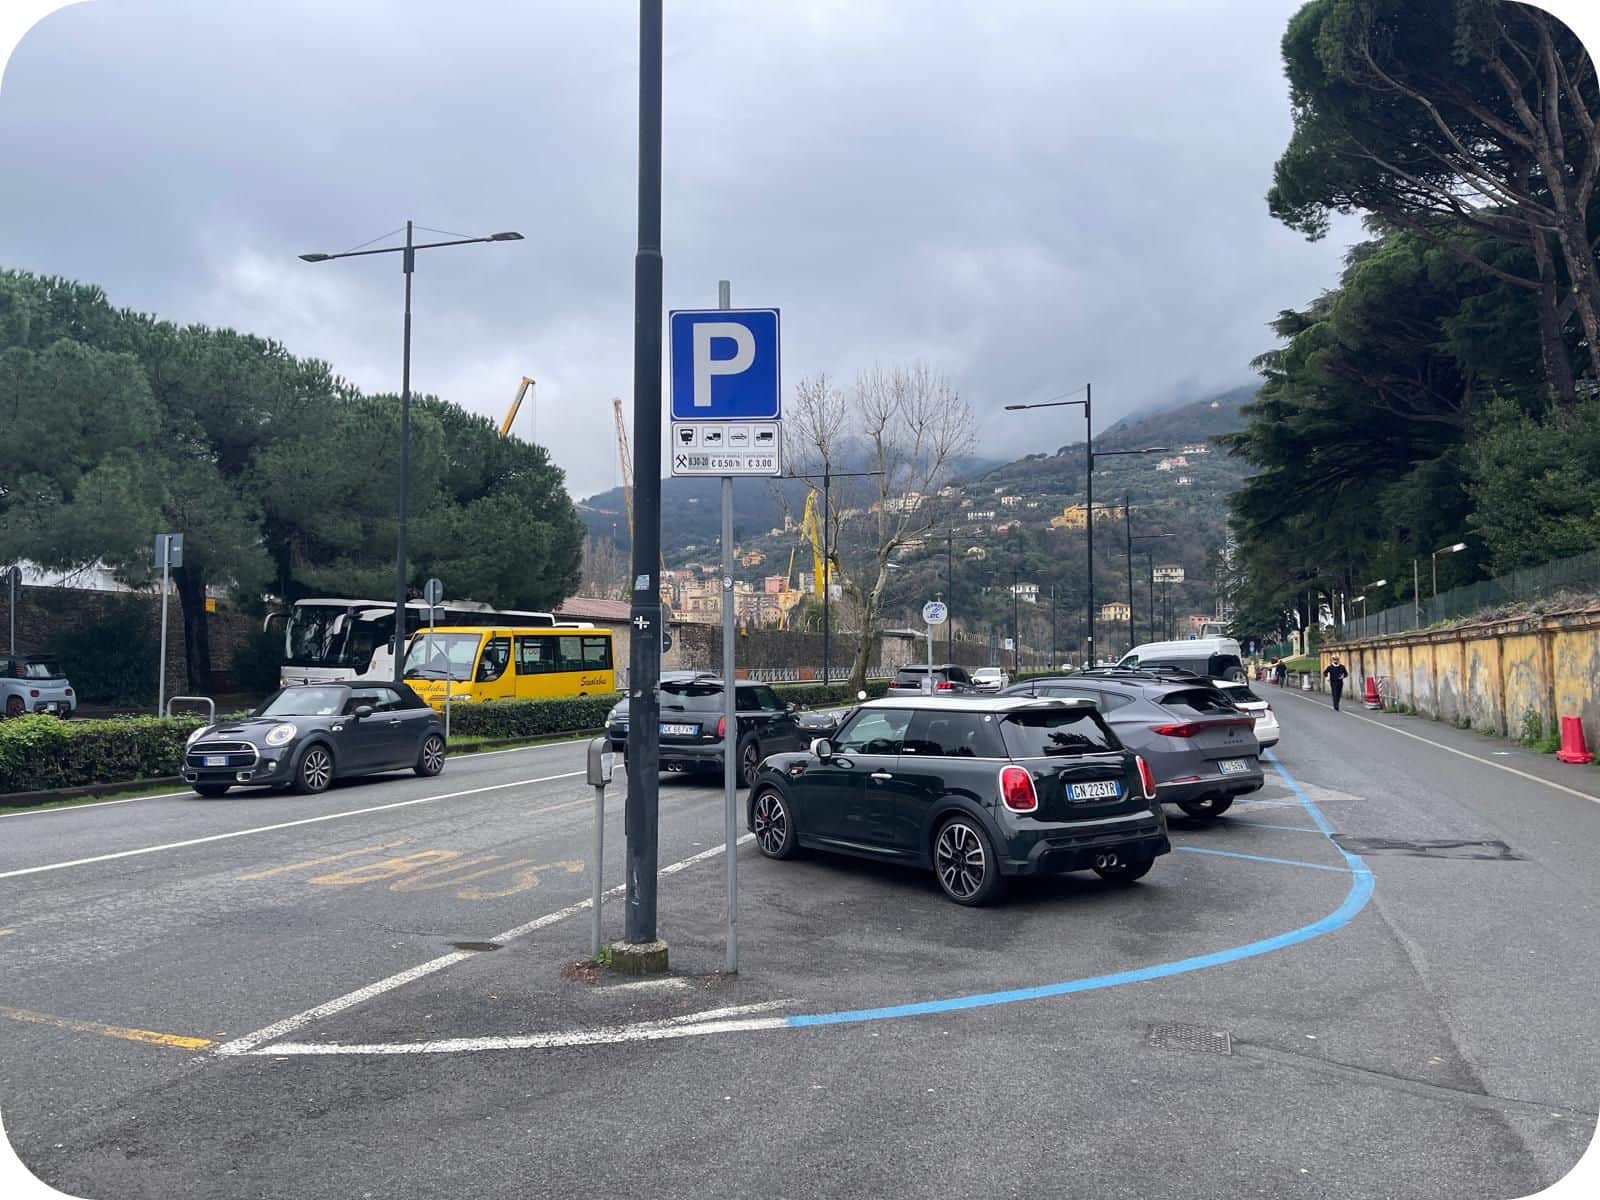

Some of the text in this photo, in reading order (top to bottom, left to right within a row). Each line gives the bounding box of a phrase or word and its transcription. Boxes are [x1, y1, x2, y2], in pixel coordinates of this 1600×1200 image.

[692, 322, 756, 407] P
[1074, 782, 1117, 798] GN 223YR
